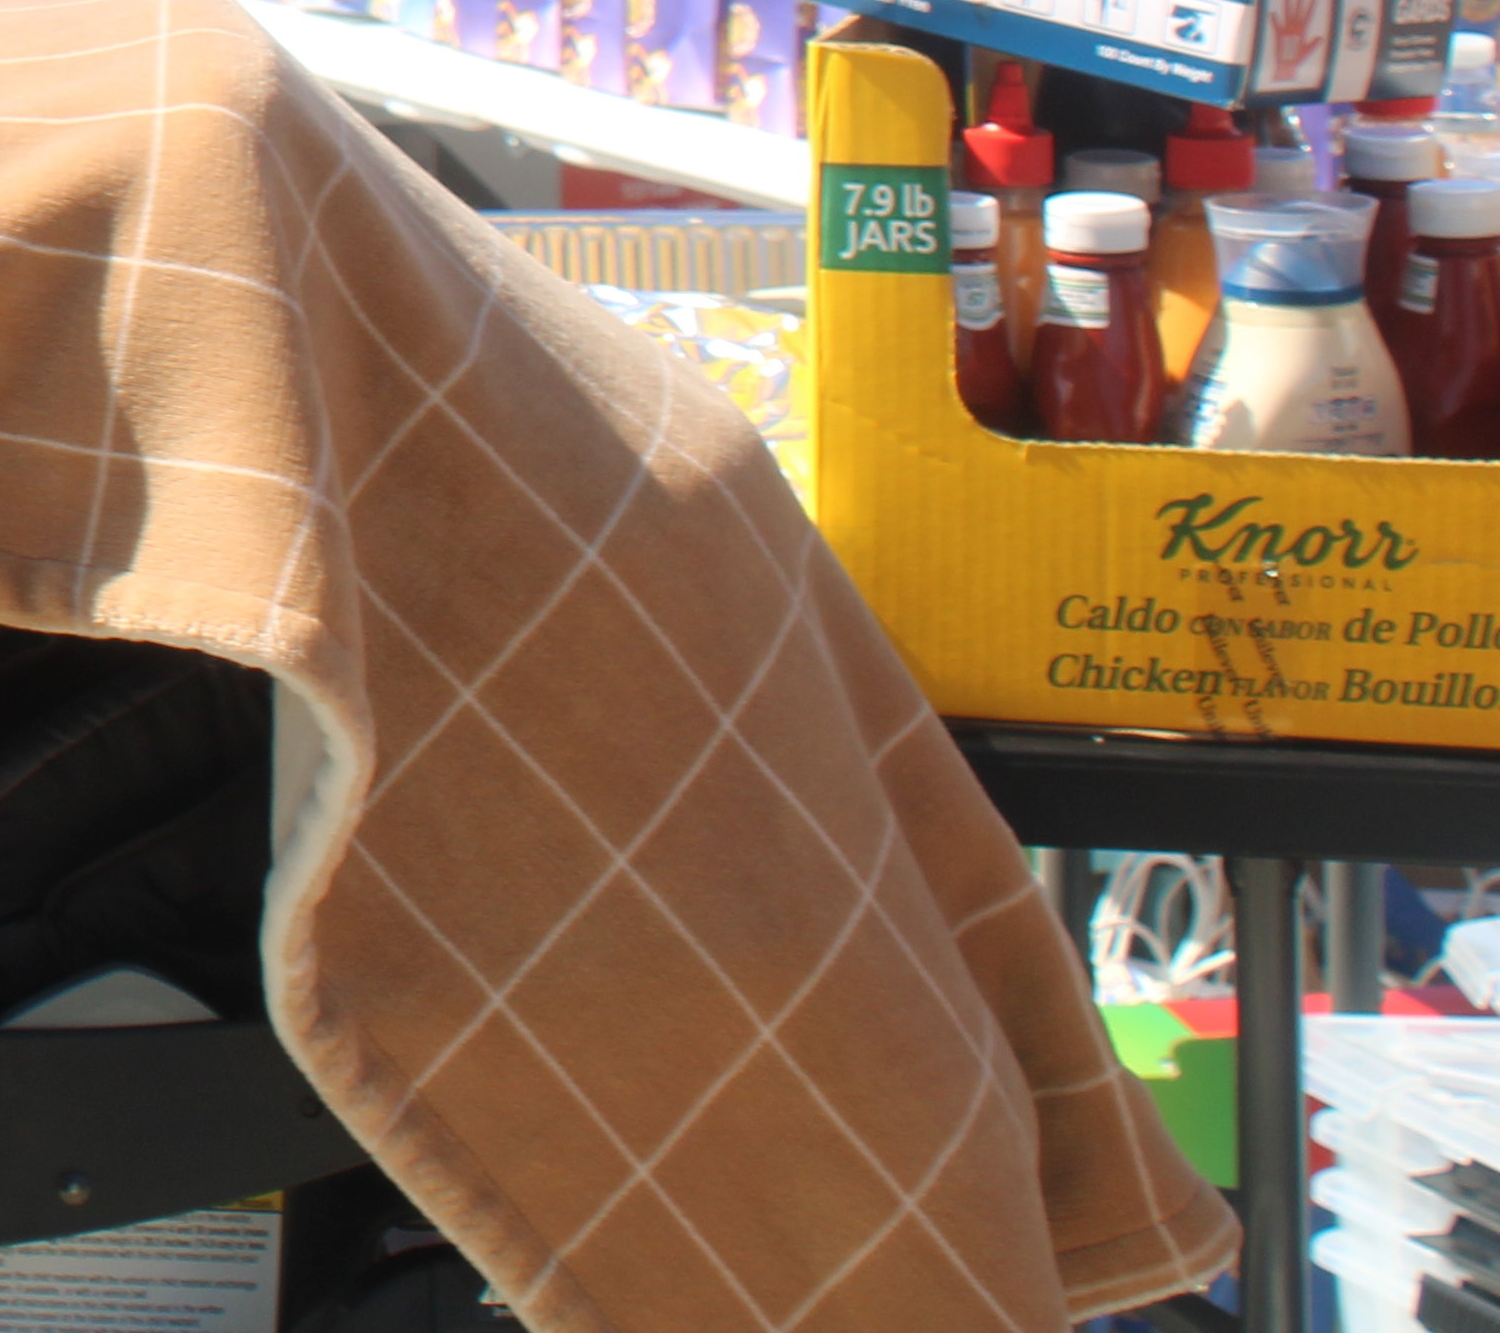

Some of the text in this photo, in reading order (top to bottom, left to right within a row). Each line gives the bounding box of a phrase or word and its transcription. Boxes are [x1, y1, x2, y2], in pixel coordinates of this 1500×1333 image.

[842, 182, 937, 219] 7.9 lb
[838, 220, 938, 261] JARS
[1156, 493, 1418, 572] Knorr
[1056, 593, 1182, 635] Caldo
[1248, 617, 1332, 642] SABOR
[1343, 607, 1397, 645] de
[1047, 652, 1500, 711] Chicken FLAVOR Bouillo
